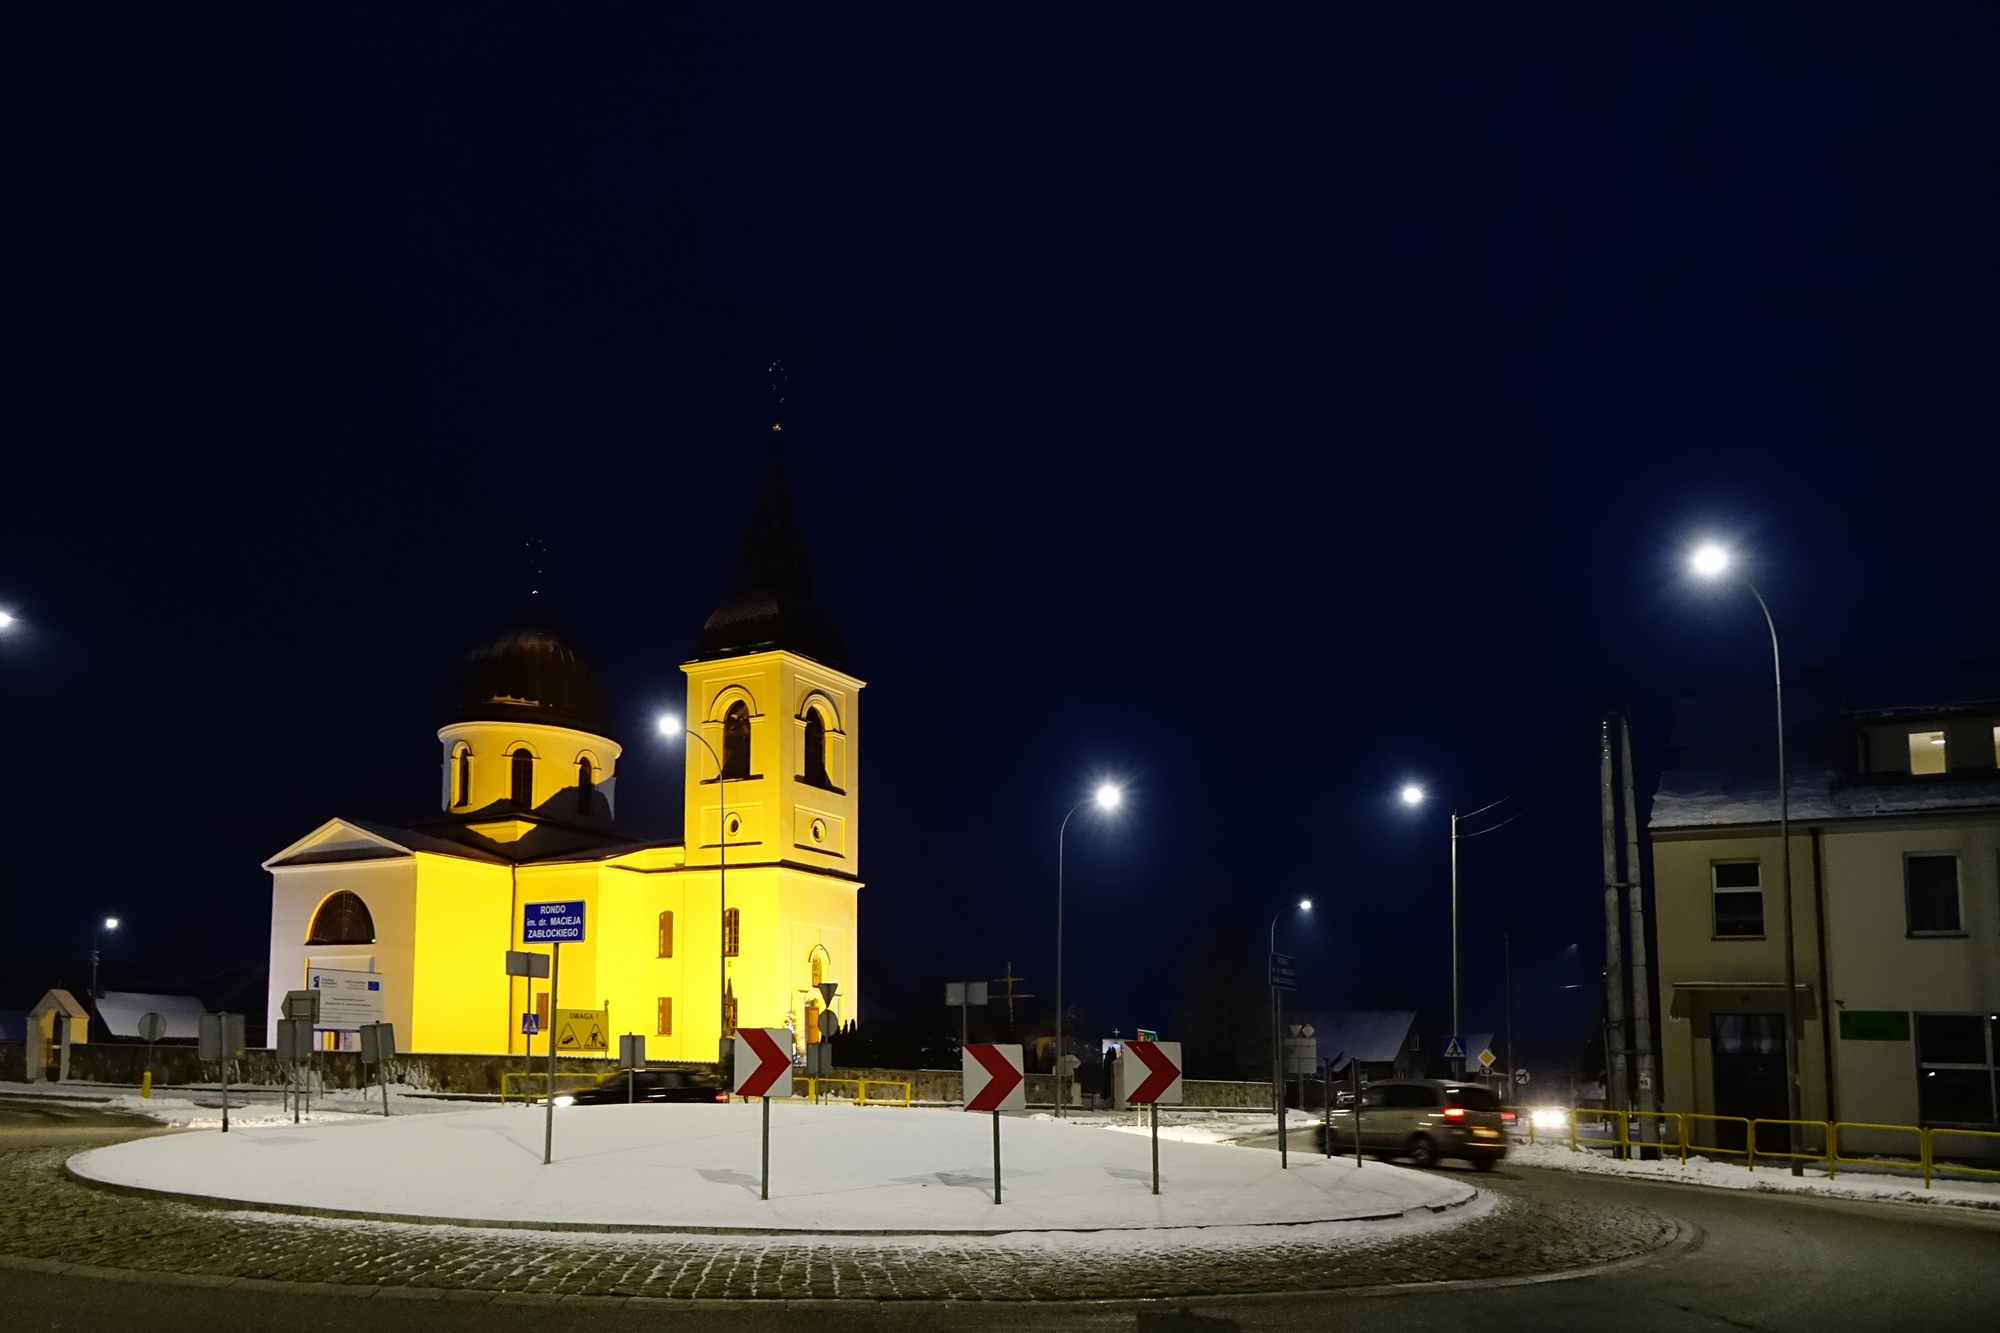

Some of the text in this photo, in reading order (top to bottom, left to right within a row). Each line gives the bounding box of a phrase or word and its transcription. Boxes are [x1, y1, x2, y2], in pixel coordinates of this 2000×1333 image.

[540, 905, 566, 914] RONDO
[526, 916, 581, 926] im. dr. MACIEJA
[528, 928, 578, 938] ZABŁOCKIEGO
[569, 1012, 594, 1020] UWAGA
